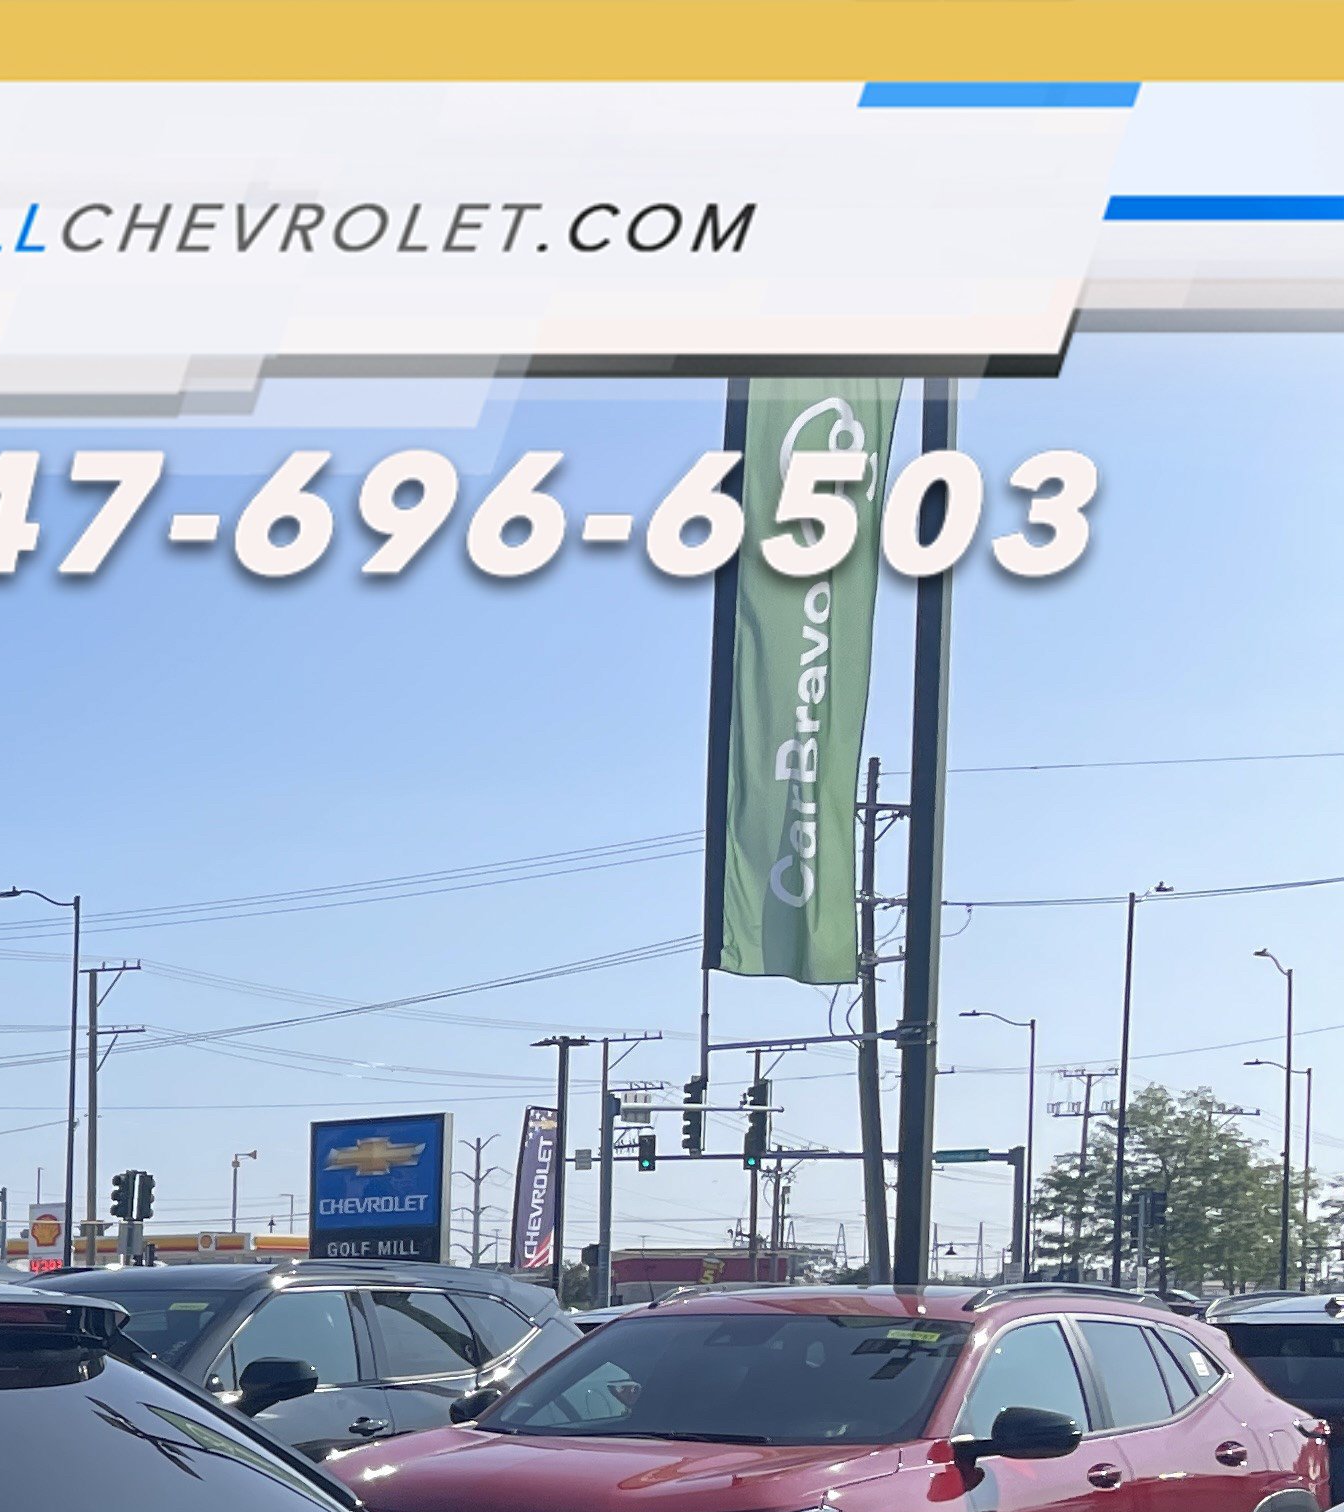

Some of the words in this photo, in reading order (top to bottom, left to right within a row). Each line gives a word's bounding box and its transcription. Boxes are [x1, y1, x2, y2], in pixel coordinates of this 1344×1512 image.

[768, 580, 832, 909] CarBravo
[319, 1194, 429, 1216] CHEVROLET
[524, 1135, 554, 1259] CHEVROLET
[327, 1241, 371, 1258] GOLF
[377, 1239, 420, 1256] MILL
